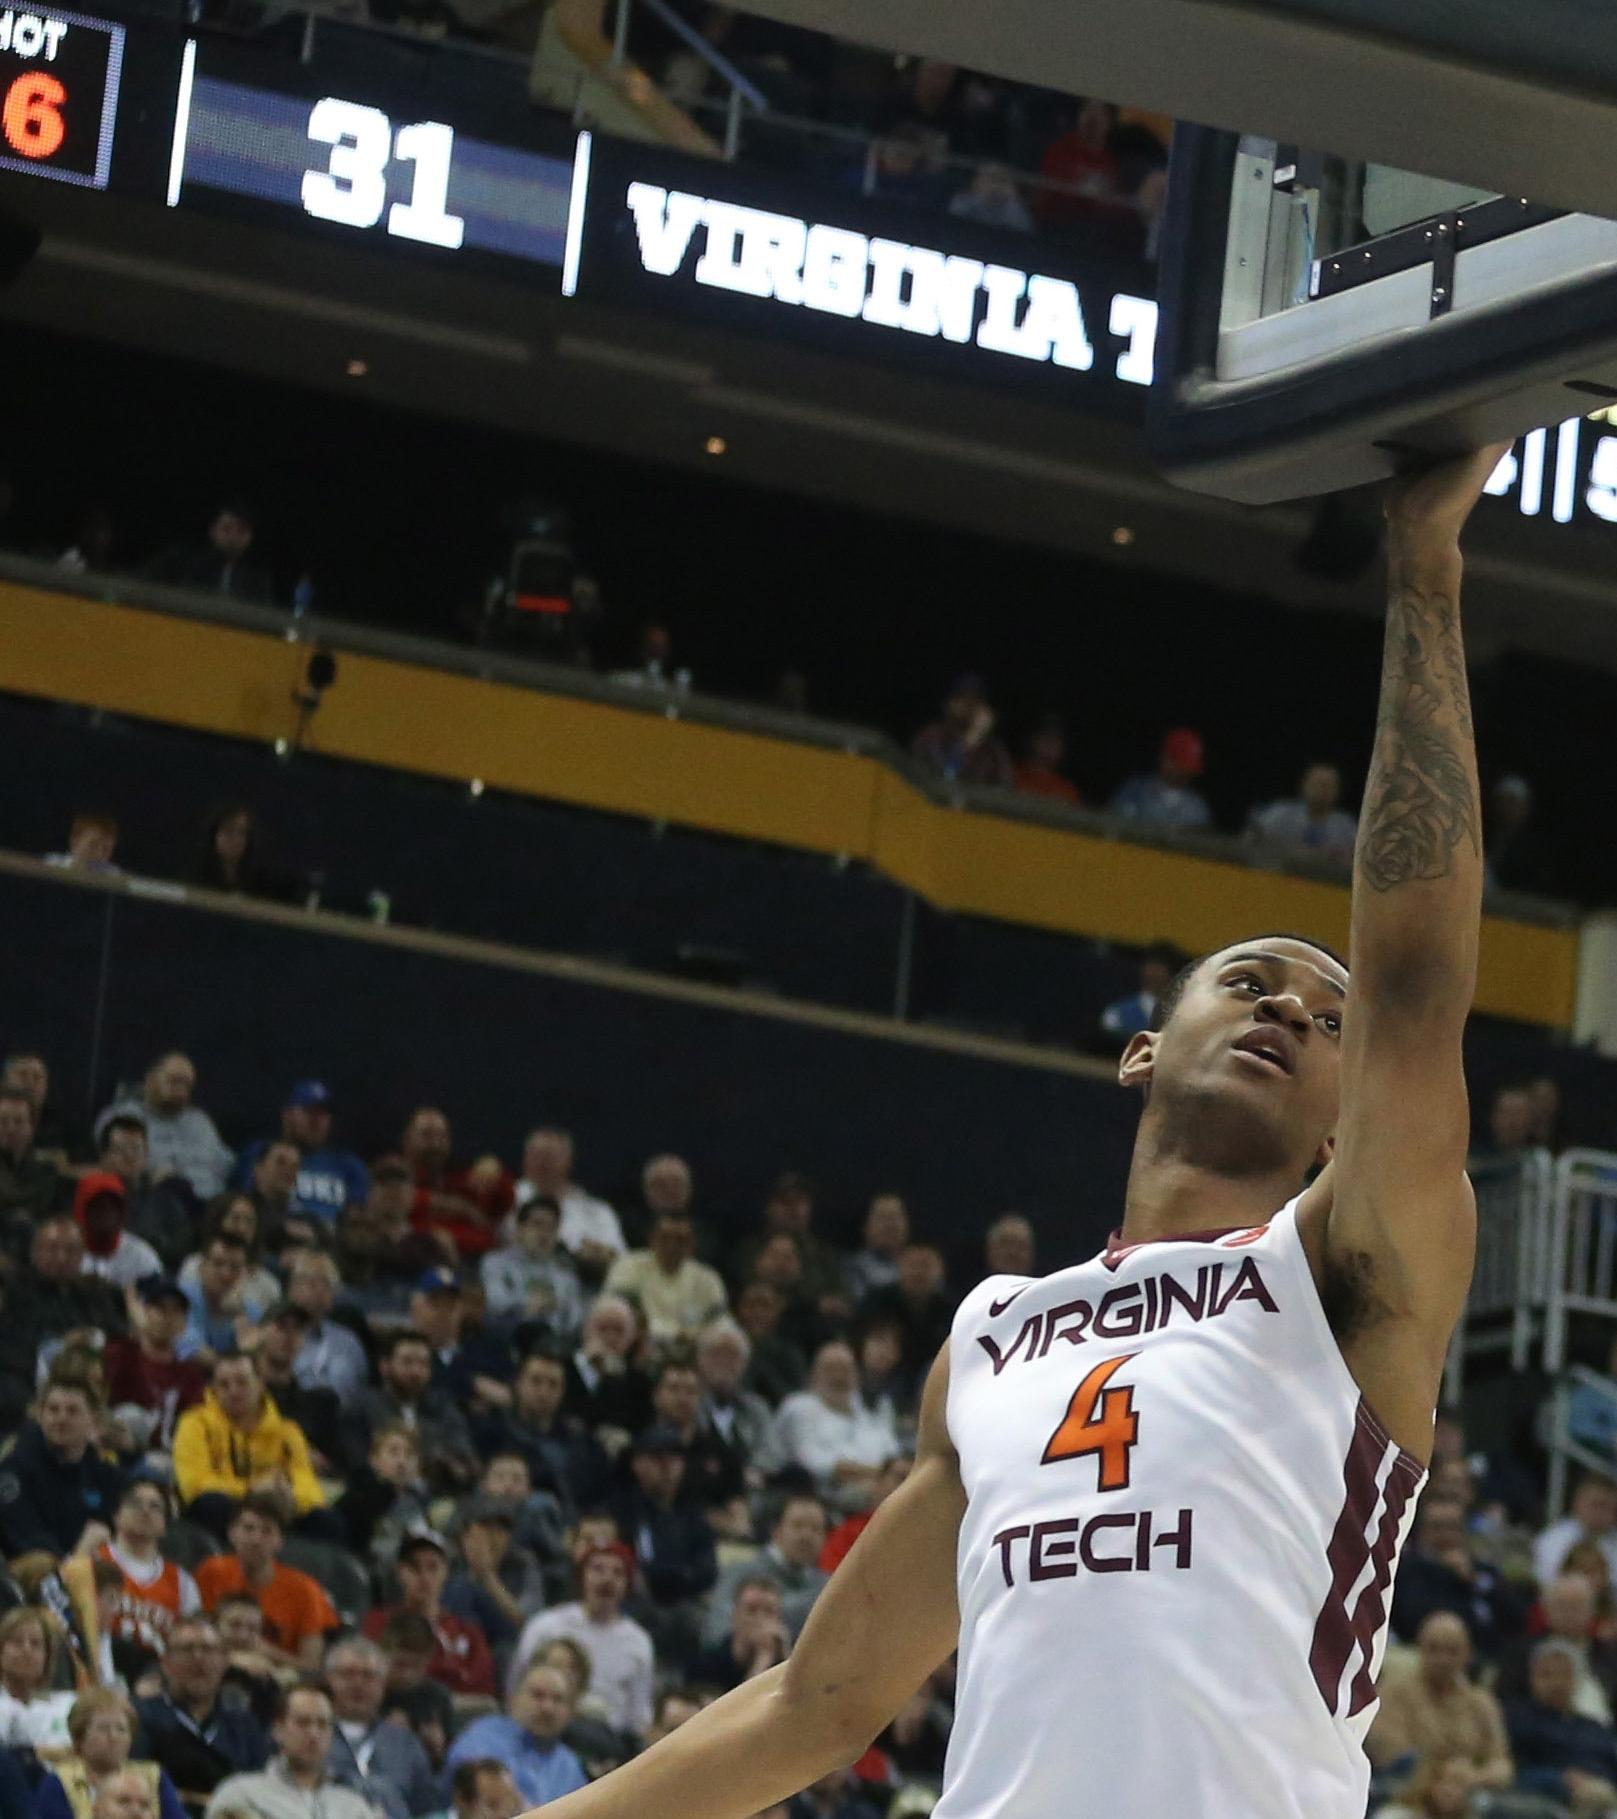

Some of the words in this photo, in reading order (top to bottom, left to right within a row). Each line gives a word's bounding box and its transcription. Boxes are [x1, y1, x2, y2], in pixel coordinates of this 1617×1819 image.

[3, 70, 67, 159] 6
[301, 97, 465, 250] 31
[626, 181, 1094, 371] VIRGINIA
[976, 1256, 1280, 1376] VIRGINIA
[1041, 1351, 1142, 1493] 4
[992, 1508, 1192, 1588] TECH
